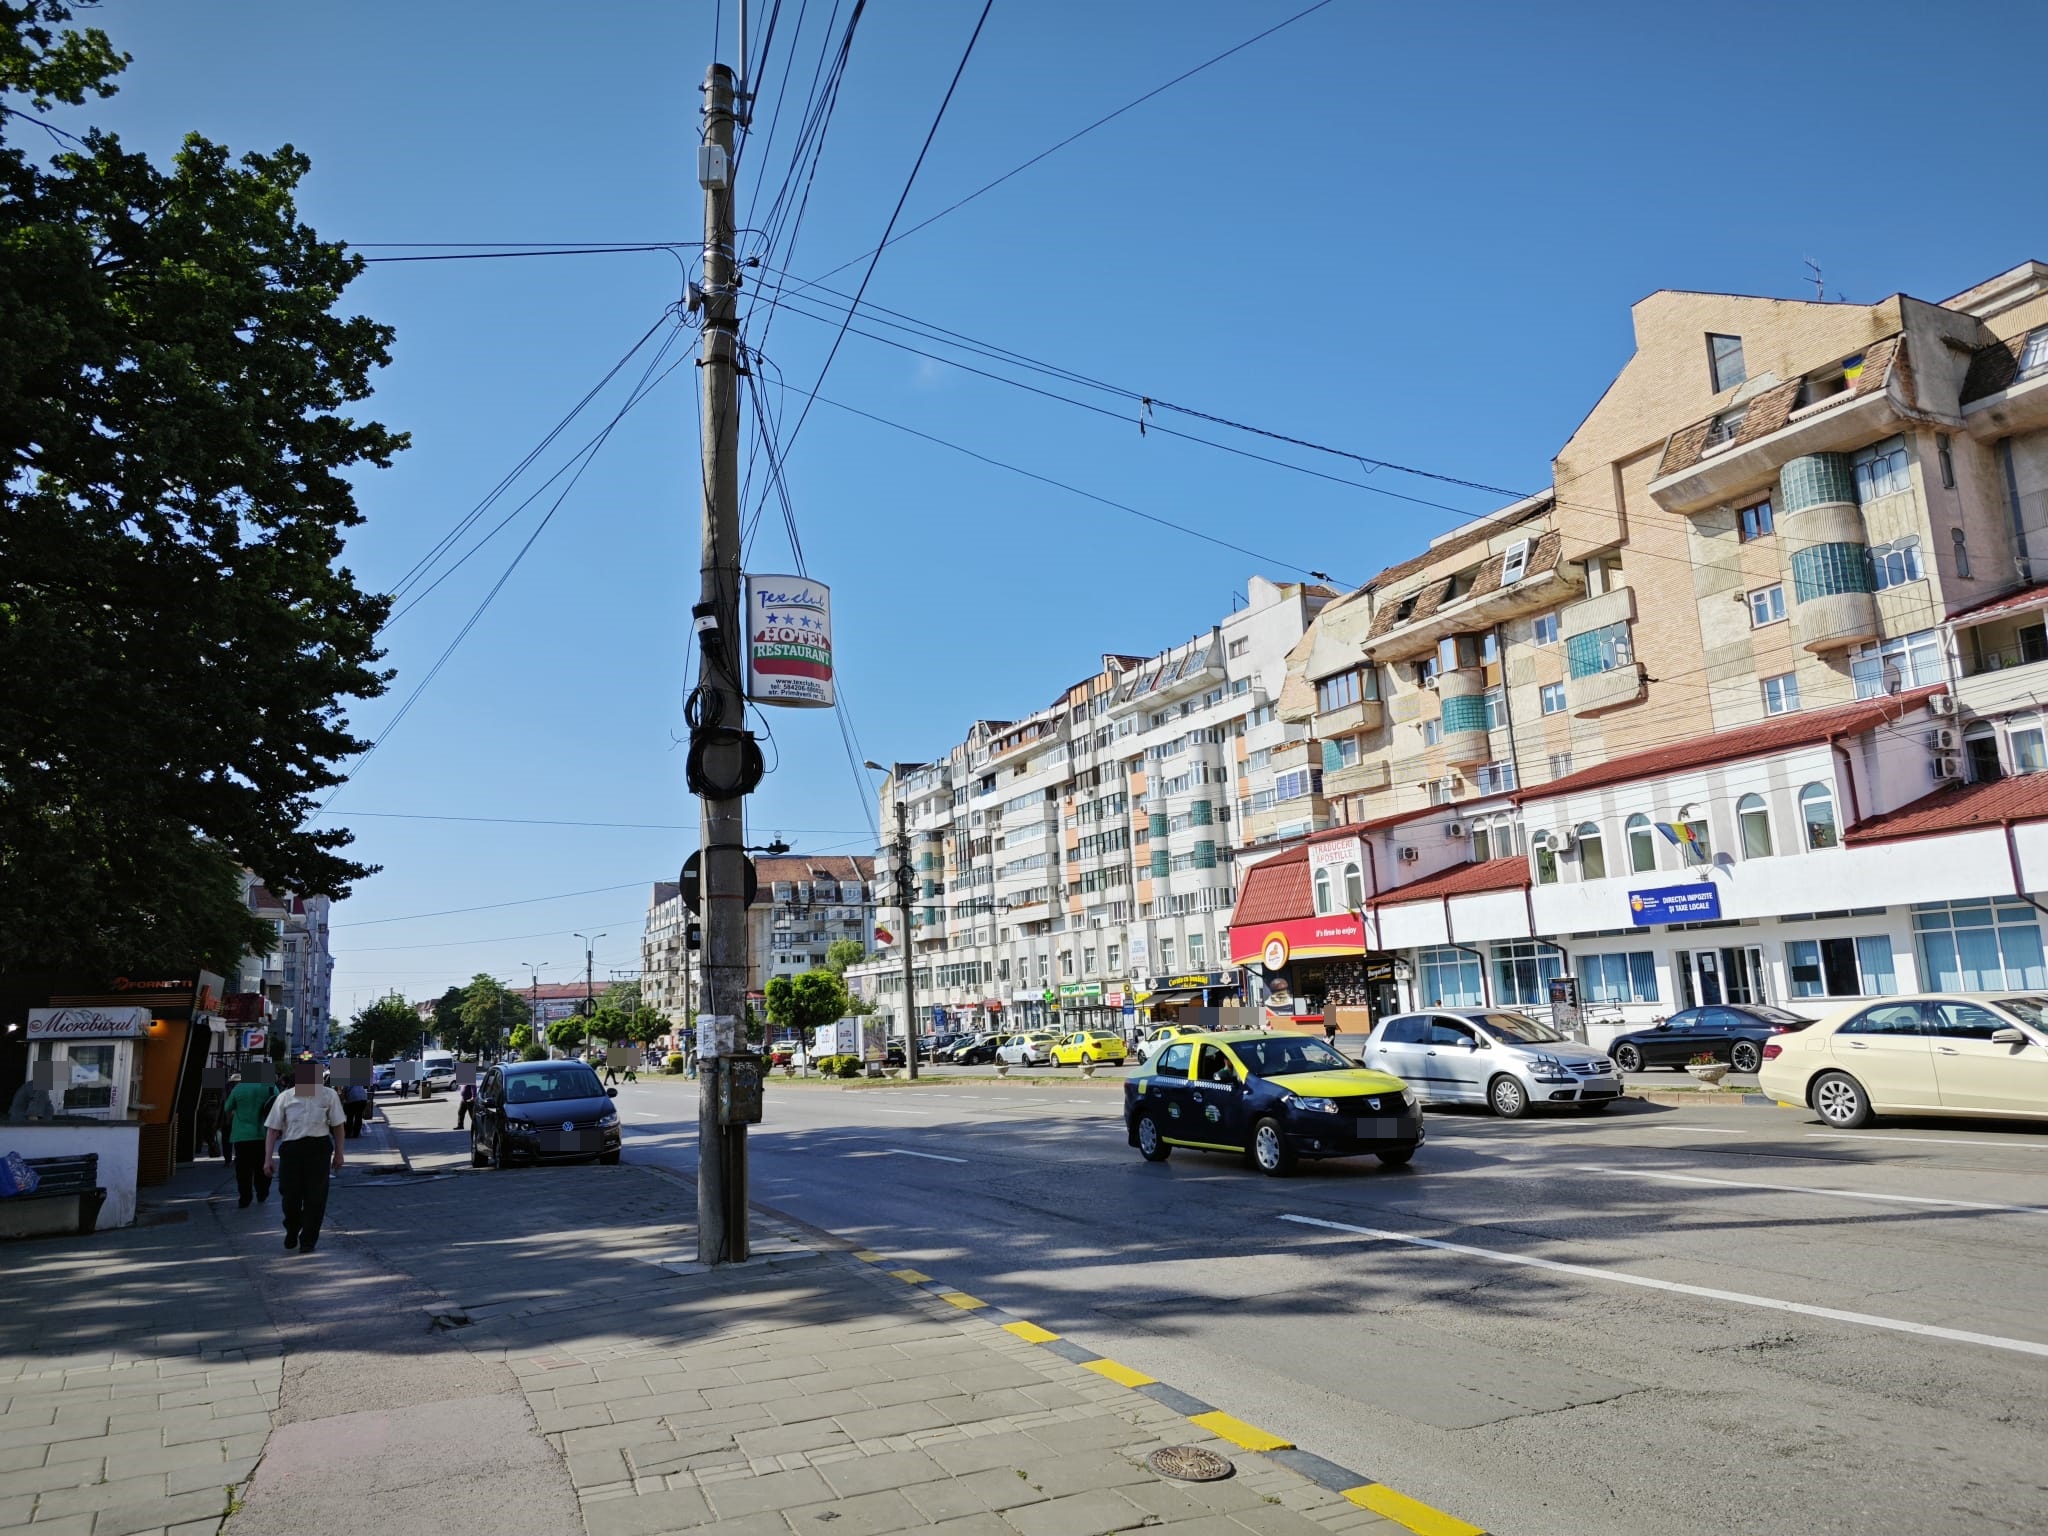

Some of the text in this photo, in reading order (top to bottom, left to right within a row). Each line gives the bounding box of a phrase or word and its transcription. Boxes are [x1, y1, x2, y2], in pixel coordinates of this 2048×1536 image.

[763, 627, 827, 649] HOTEL
[757, 644, 831, 665] RESTAURANT
[1314, 839, 1354, 854] TRADUCERI
[1316, 850, 1353, 863] APOSTILLE
[1687, 892, 1713, 902] IMPOZITE
[1675, 904, 1688, 912] TAXE
[1689, 902, 1710, 911] LOCALE
[128, 979, 193, 989] FORNETTI
[32, 1009, 137, 1034] Microbuzul
